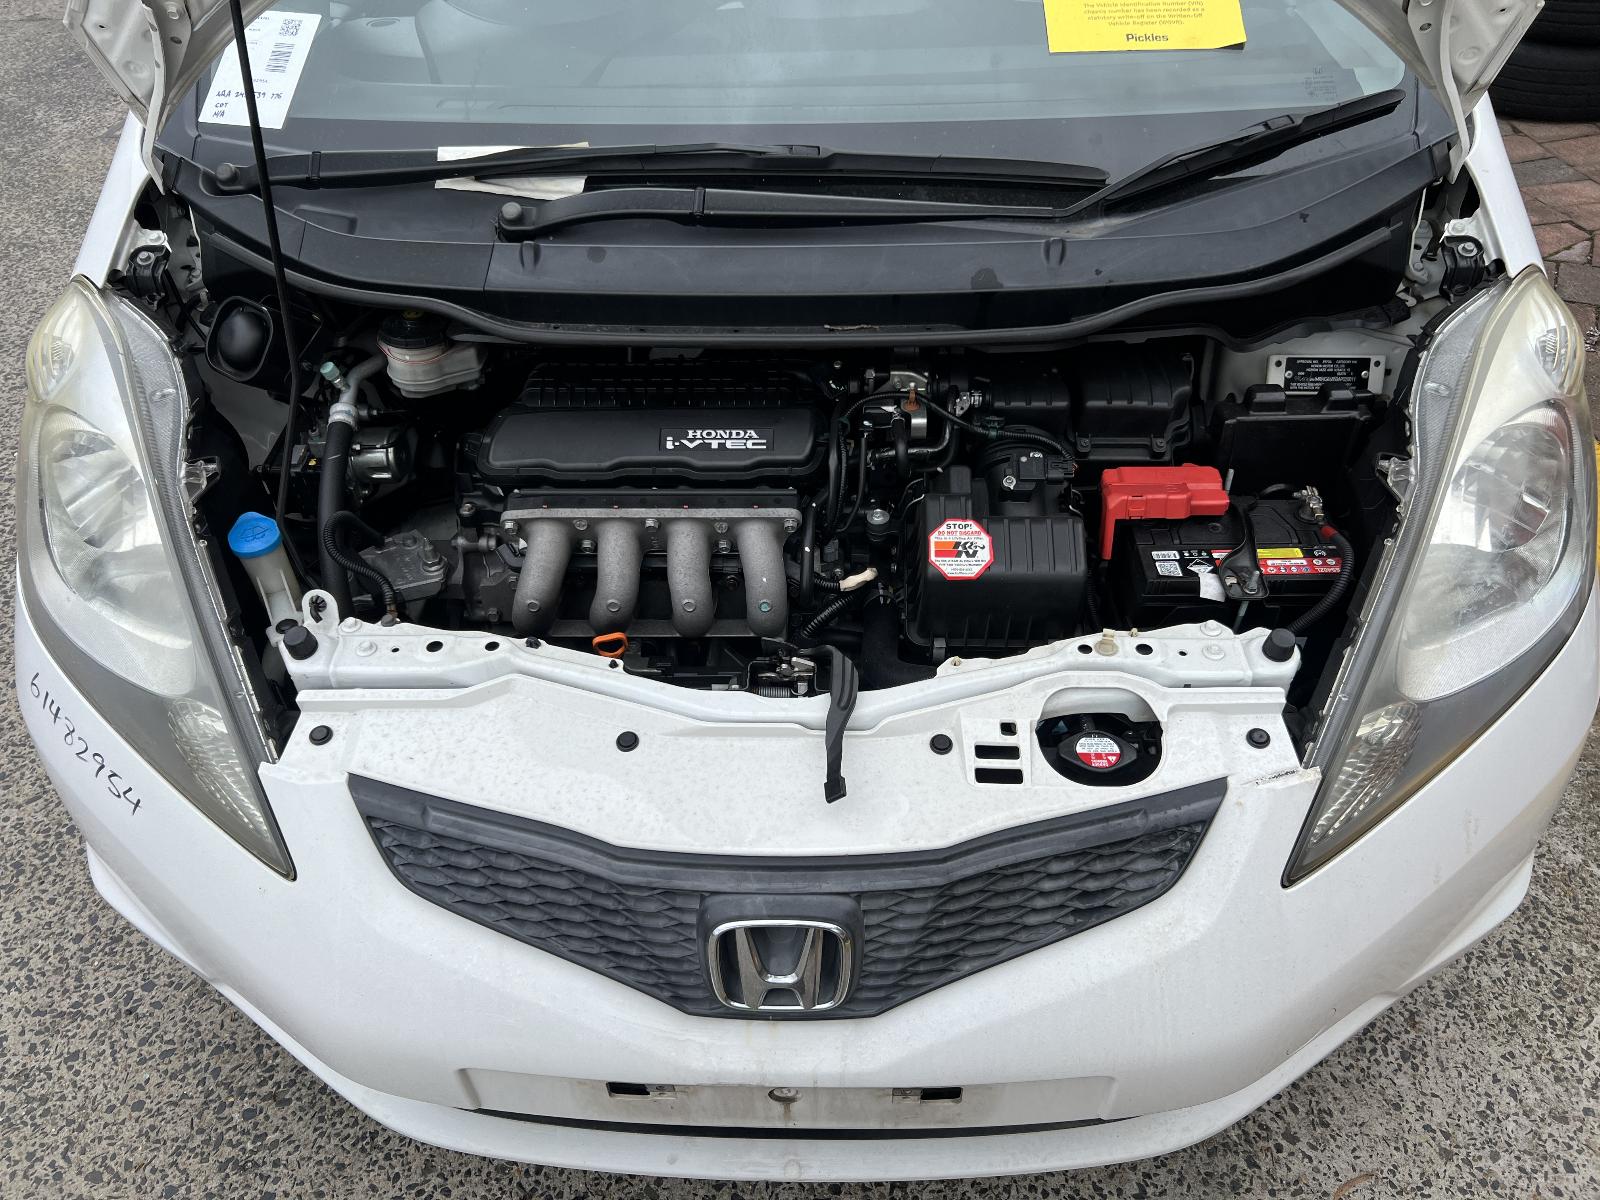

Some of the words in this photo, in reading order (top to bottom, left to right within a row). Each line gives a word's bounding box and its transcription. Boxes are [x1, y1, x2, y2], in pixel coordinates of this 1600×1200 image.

[1125, 33, 1169, 42] Pickles
[687, 429, 759, 439] HONDA
[665, 436, 767, 450] i-VTEC
[30, 672, 141, 816] 61482954
